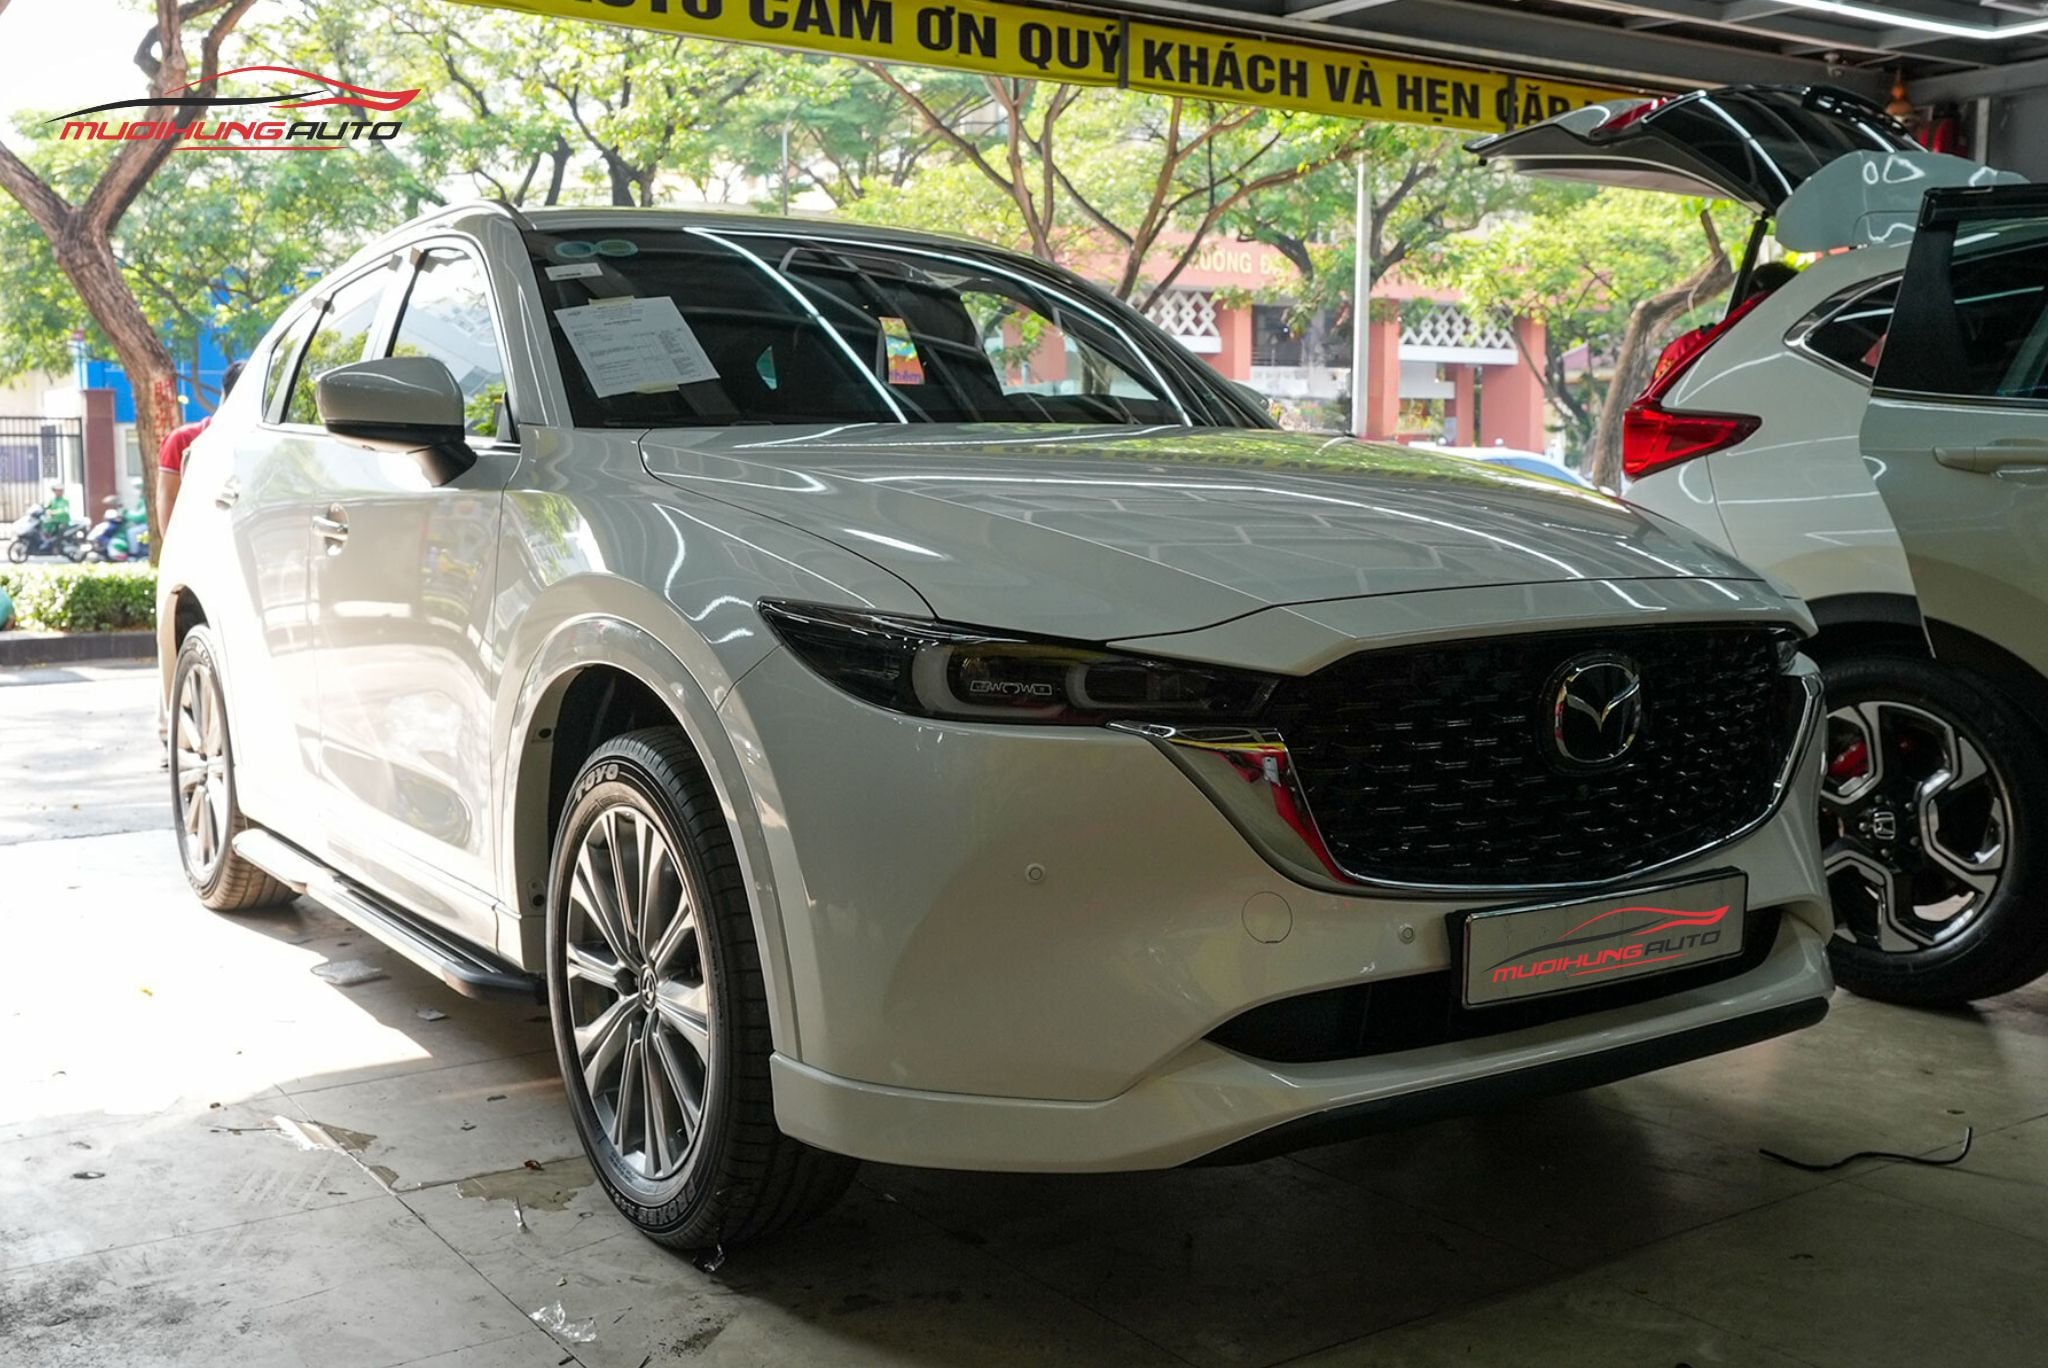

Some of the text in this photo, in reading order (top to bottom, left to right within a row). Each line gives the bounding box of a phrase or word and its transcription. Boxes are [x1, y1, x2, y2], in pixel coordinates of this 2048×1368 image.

[916, 6, 997, 59] ƠN
[1018, 23, 1120, 74] QUÝ
[1143, 39, 1308, 98] KHÁCH
[1323, 60, 1382, 107] VÀ
[1396, 73, 1480, 122] HẸN
[575, 763, 620, 802] TOYO
